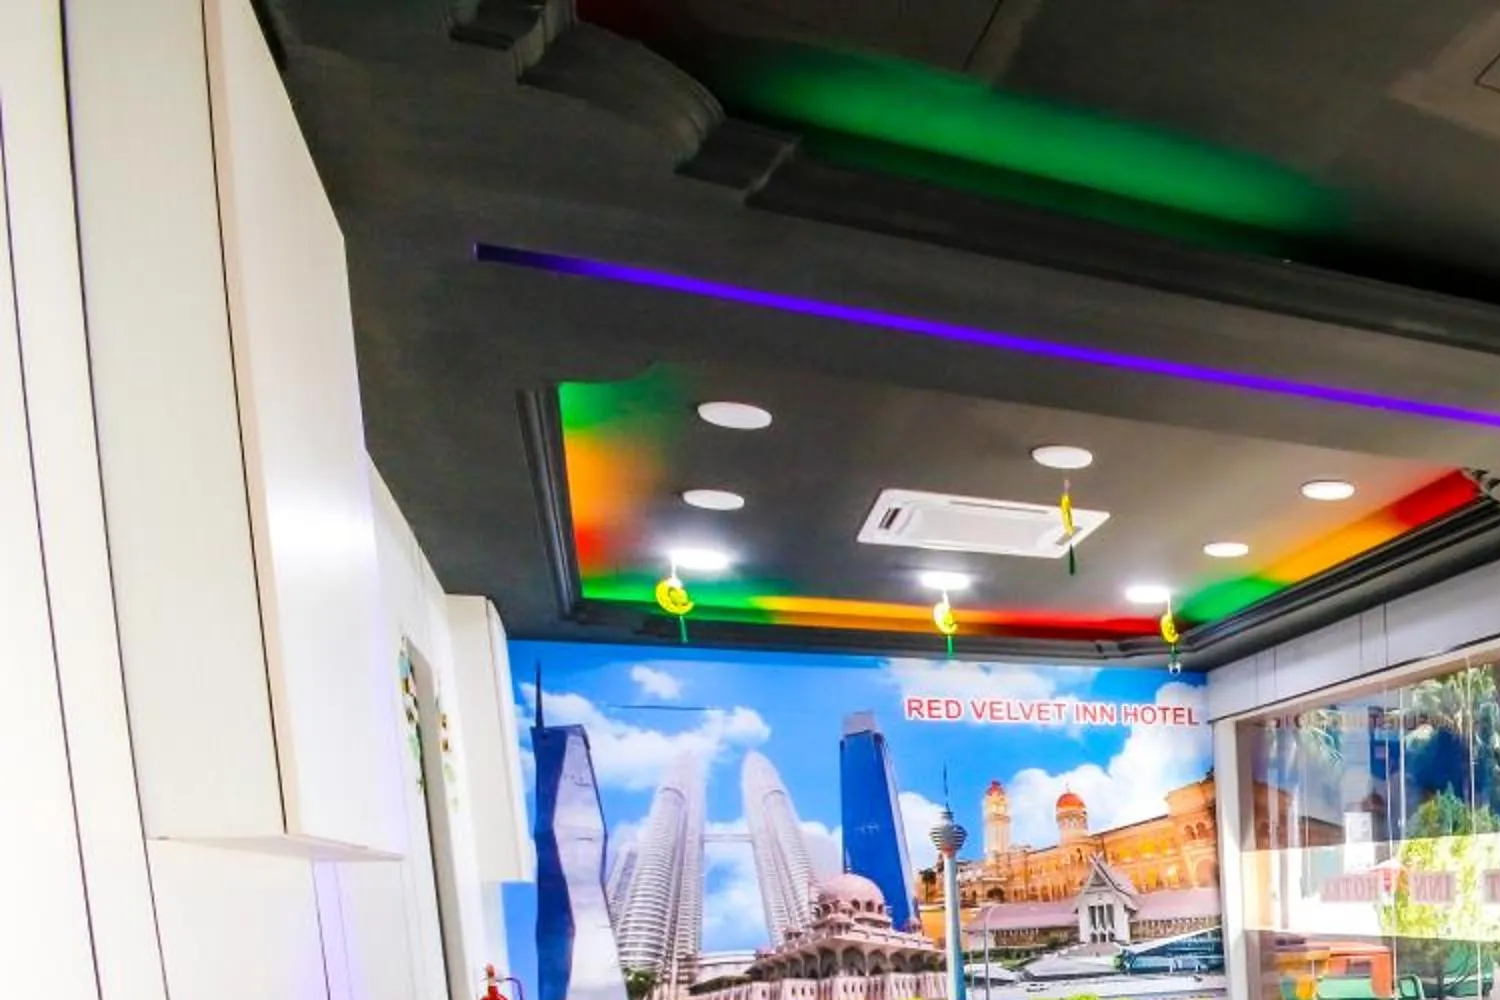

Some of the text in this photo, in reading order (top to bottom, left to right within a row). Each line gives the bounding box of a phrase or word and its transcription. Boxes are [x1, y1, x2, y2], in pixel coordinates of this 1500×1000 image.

[906, 698, 1200, 726] RED VELVET INN HOTEL
